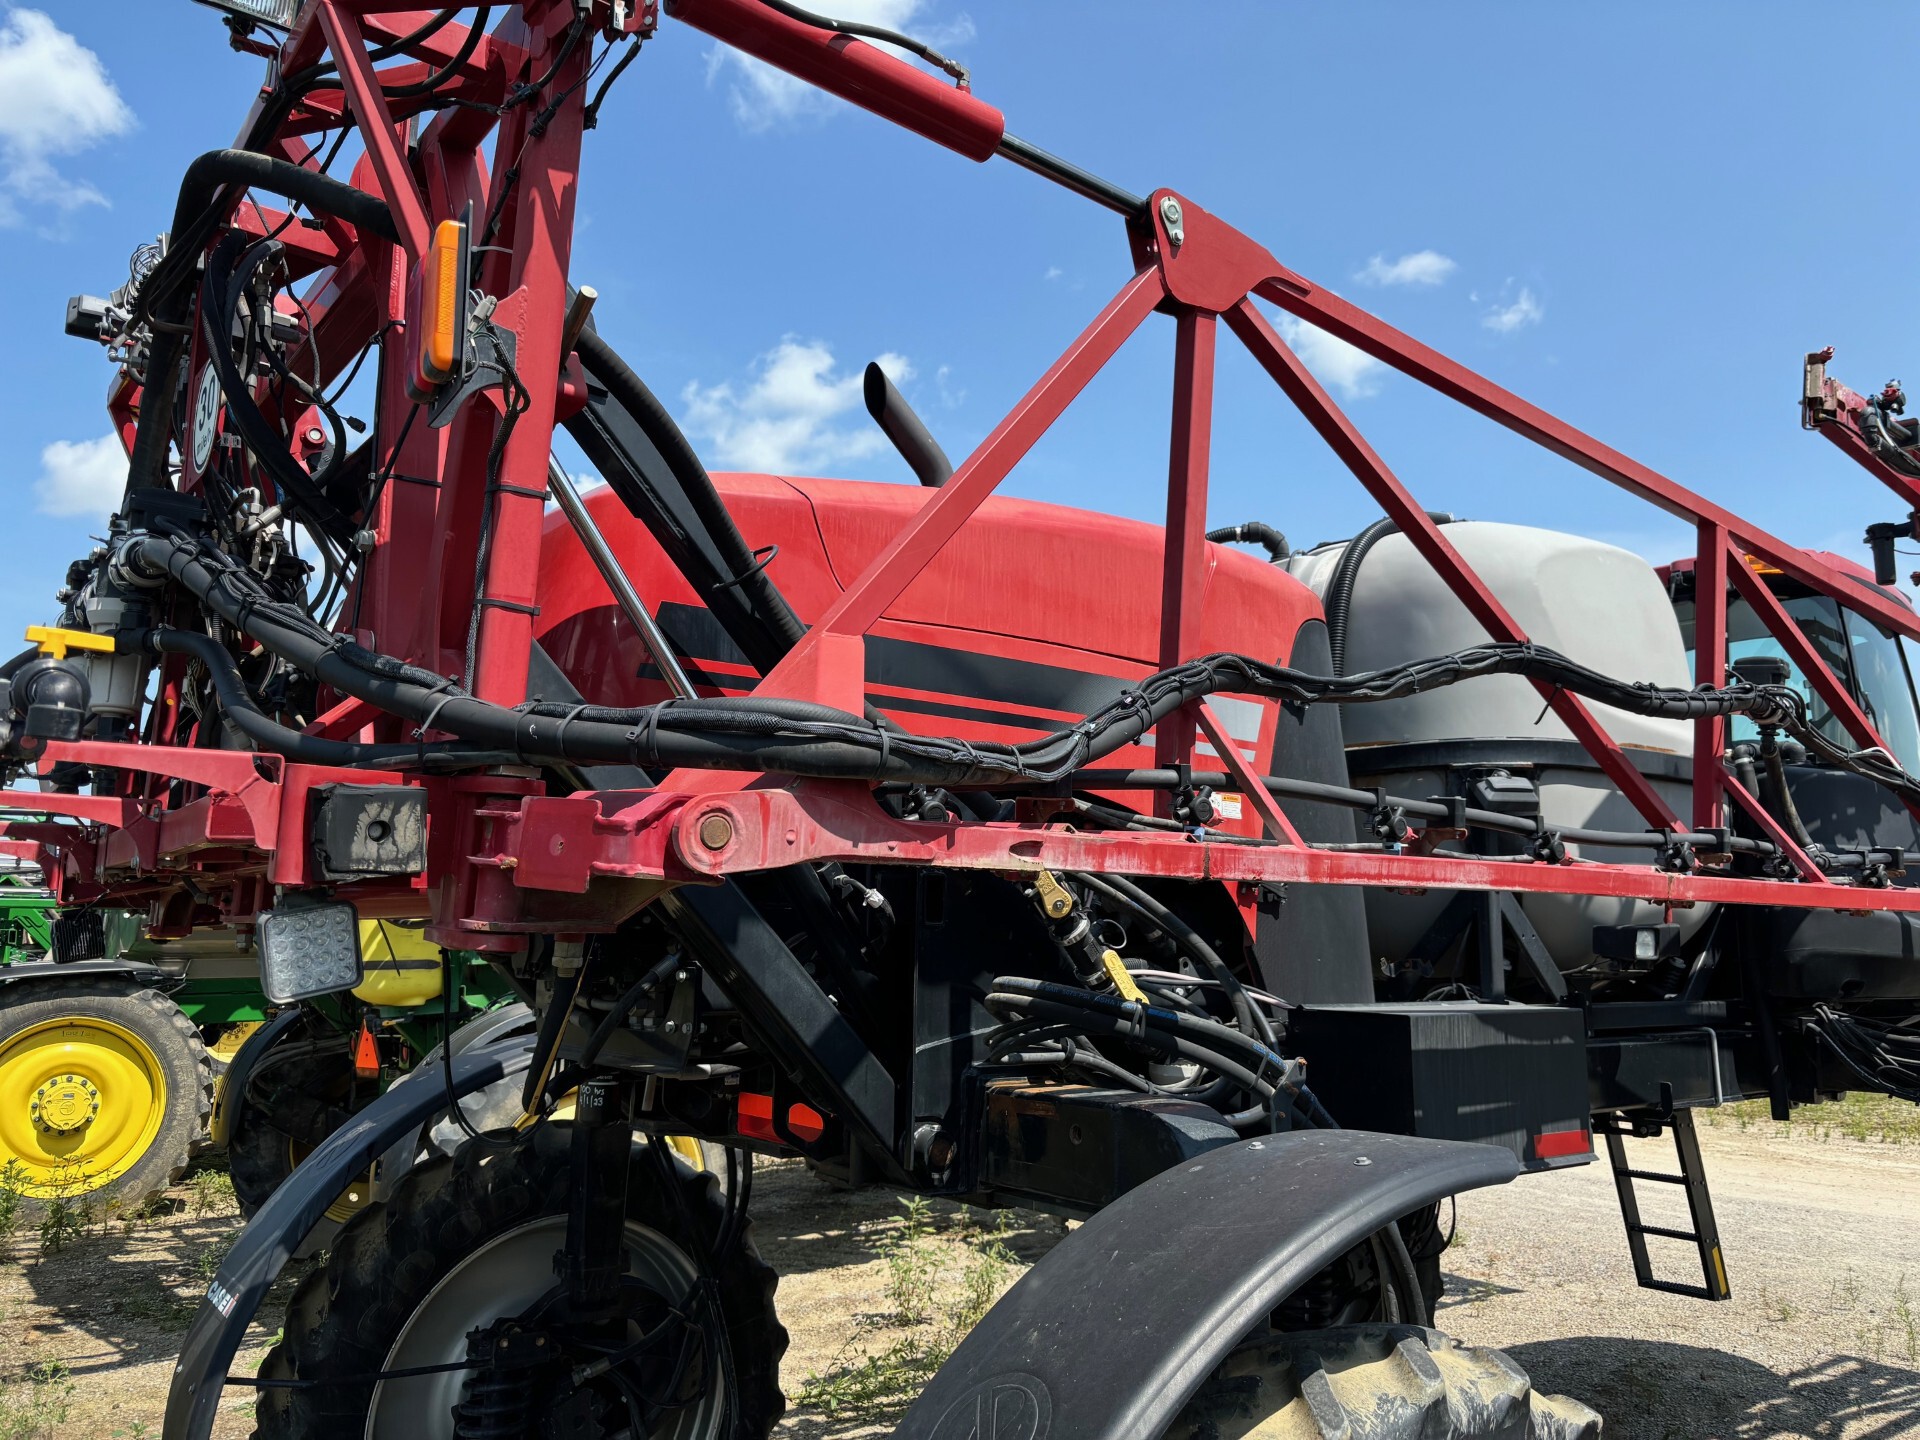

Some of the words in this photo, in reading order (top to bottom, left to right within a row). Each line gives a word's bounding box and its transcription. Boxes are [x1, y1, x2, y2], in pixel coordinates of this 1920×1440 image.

[198, 374, 216, 432] 30
[594, 1086, 605, 1096] hrs
[207, 1280, 231, 1313] CASE
